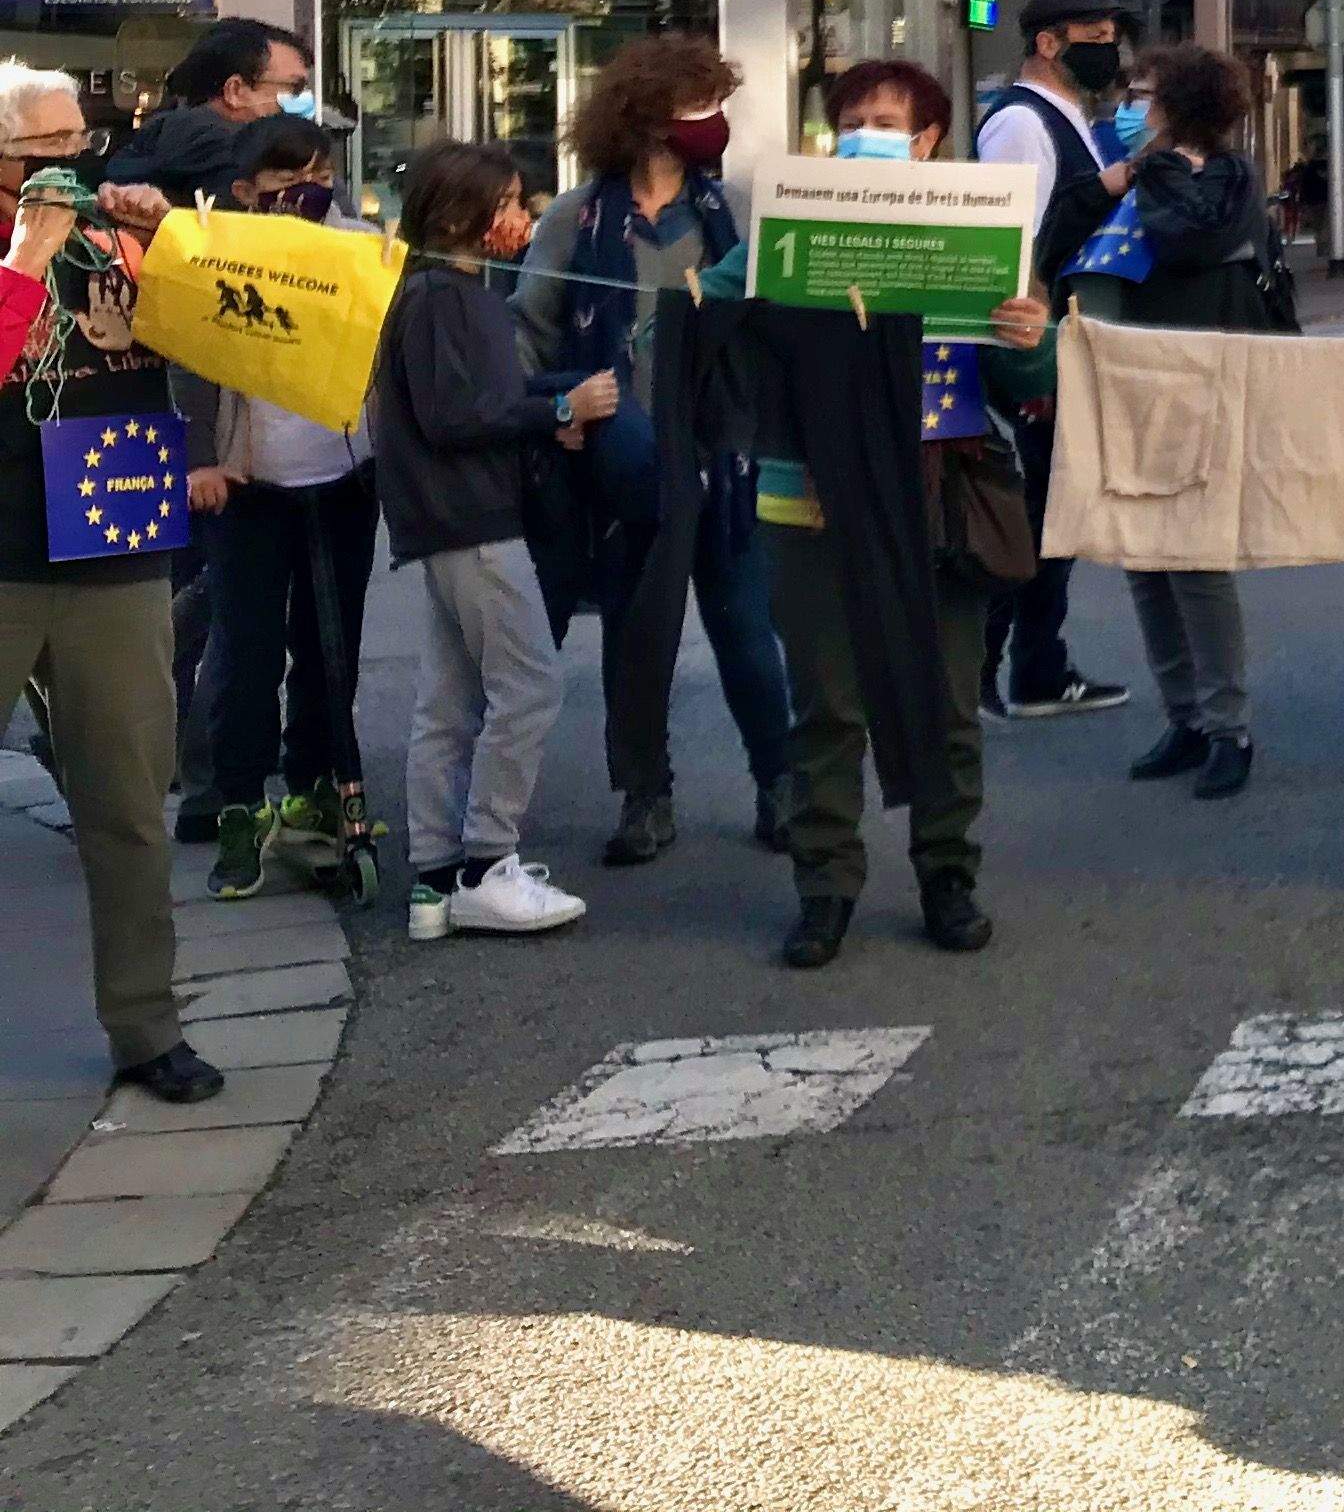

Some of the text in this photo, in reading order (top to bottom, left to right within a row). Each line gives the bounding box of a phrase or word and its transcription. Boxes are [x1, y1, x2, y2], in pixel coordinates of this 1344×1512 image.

[776, 183, 834, 201] Demanem
[862, 190, 905, 206] Europa
[907, 191, 922, 205] de
[926, 190, 959, 207] Drets
[810, 234, 836, 247] VIES
[839, 235, 882, 249] LEGALS
[892, 236, 945, 251] SEGURES
[774, 233, 796, 278] 1
[189, 255, 341, 297] REFUGEES WELCOME
[106, 475, 155, 493] FRANÇA
